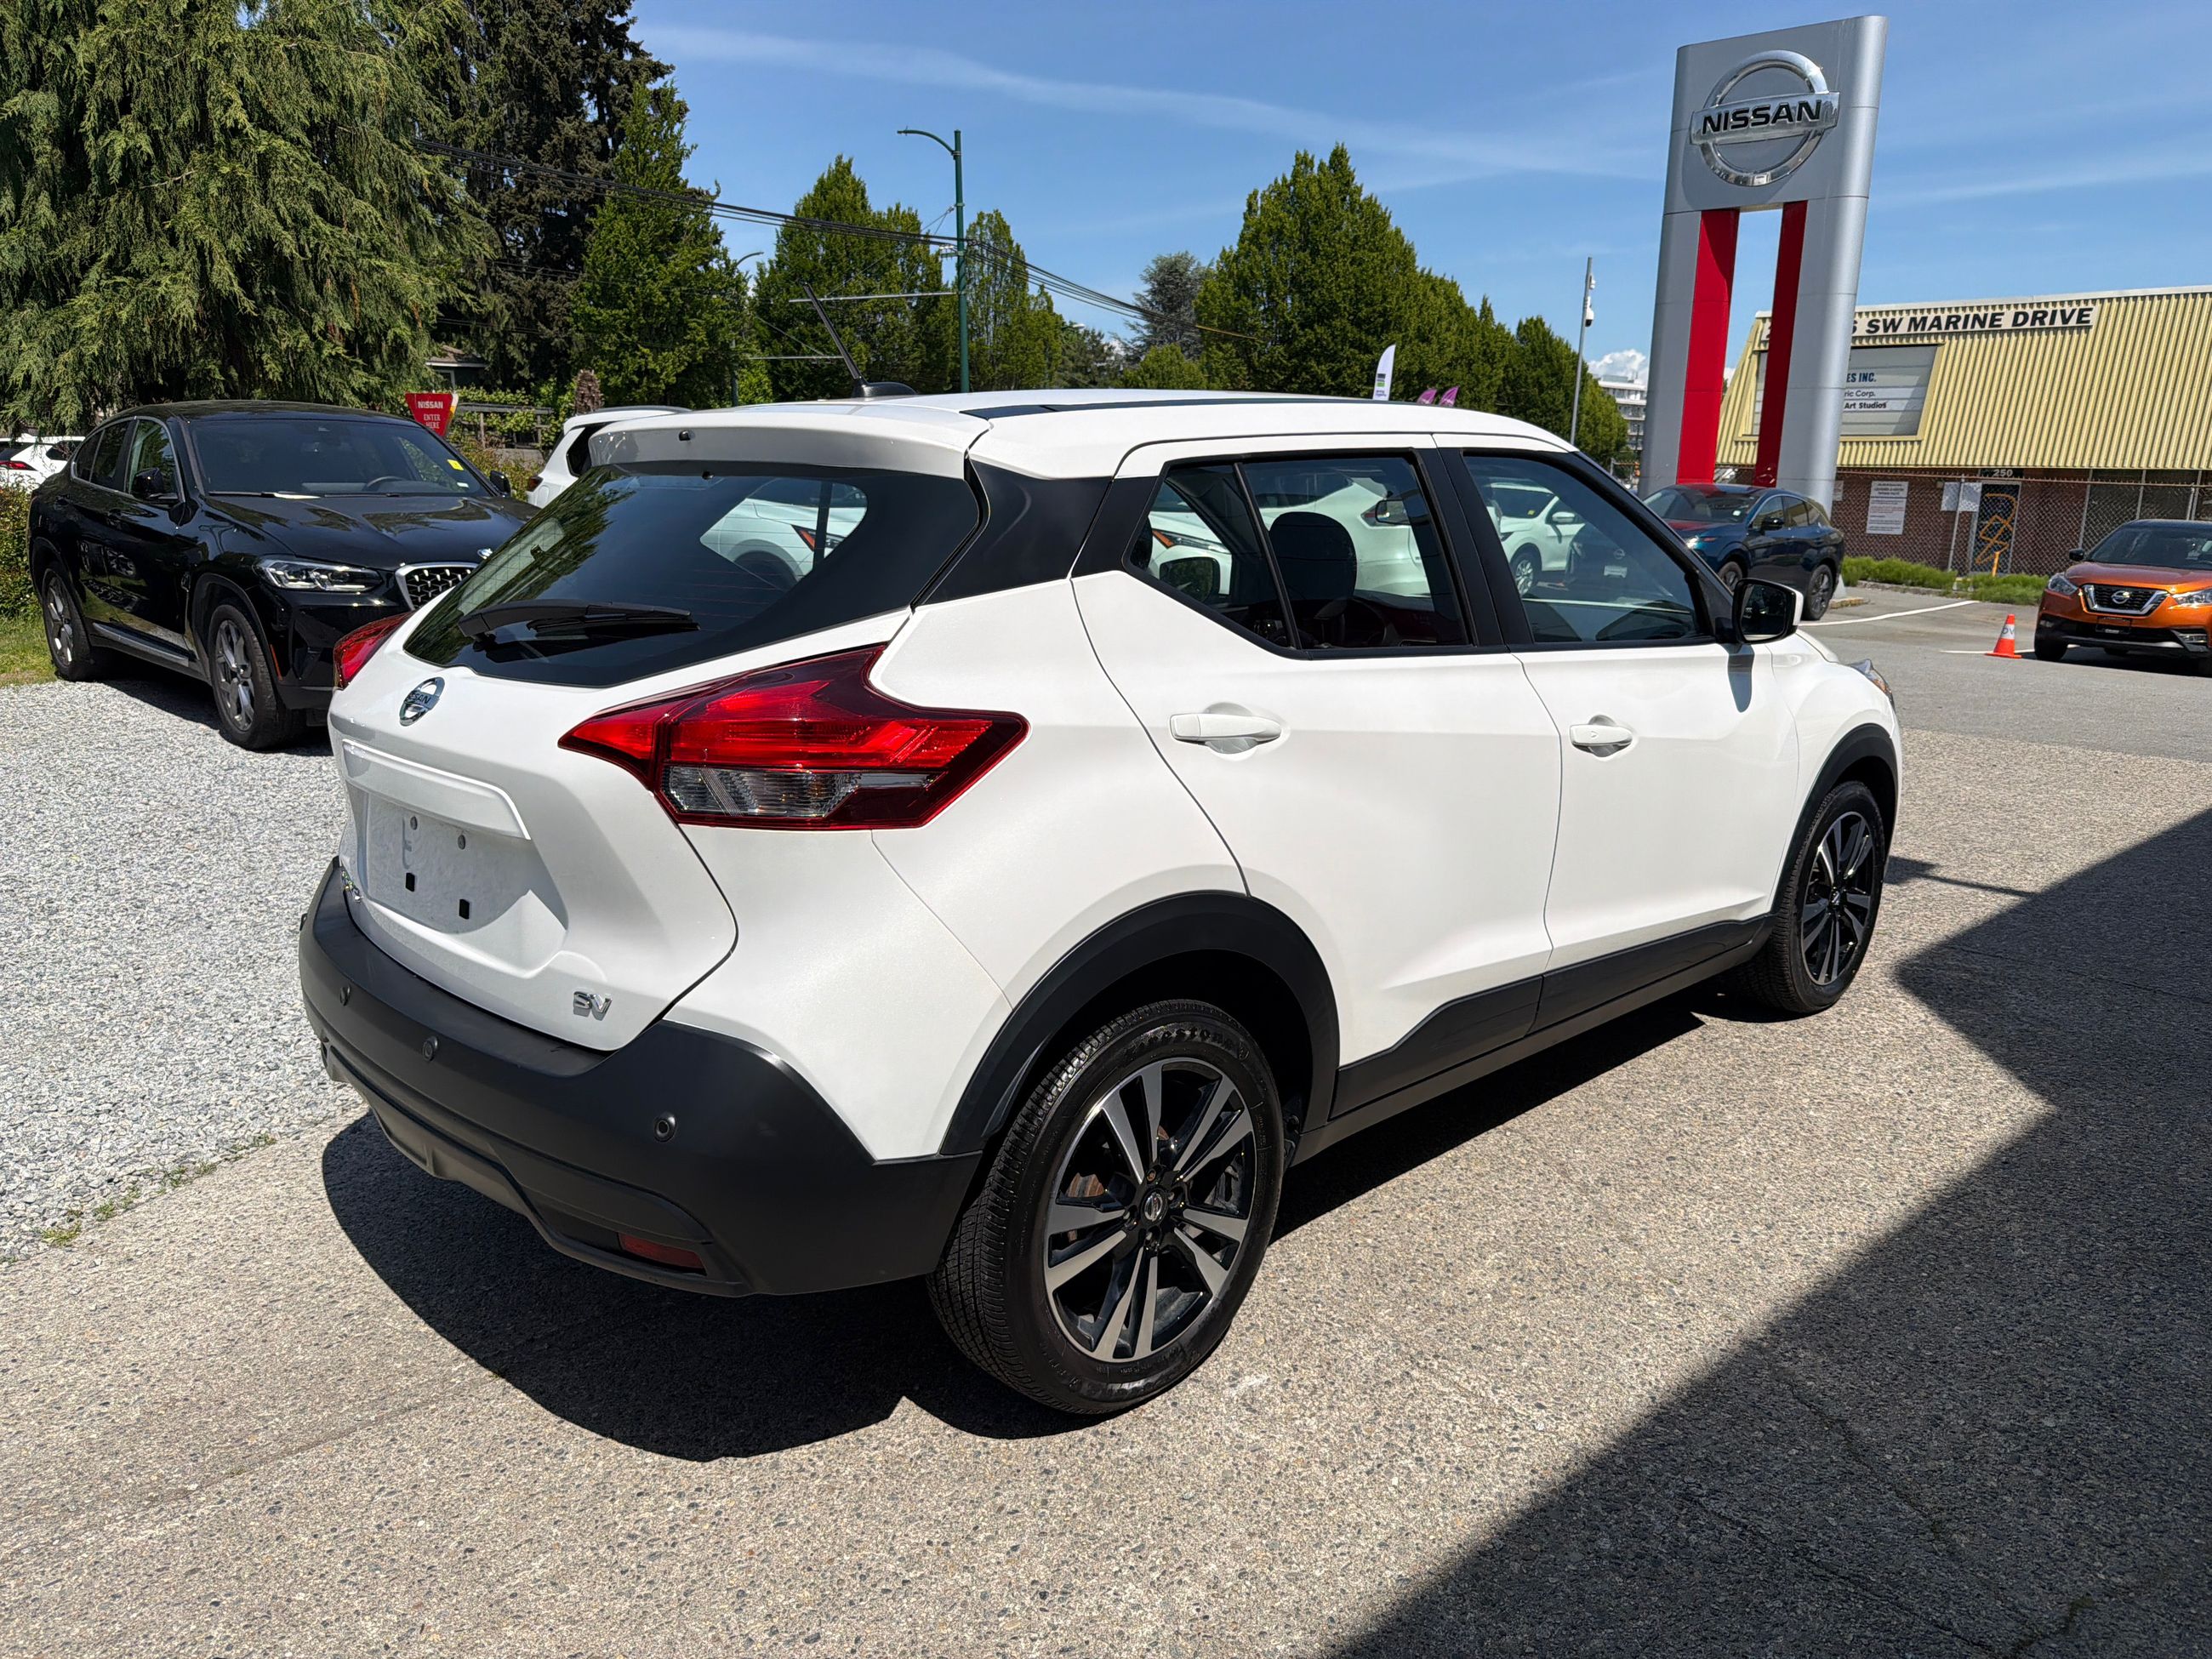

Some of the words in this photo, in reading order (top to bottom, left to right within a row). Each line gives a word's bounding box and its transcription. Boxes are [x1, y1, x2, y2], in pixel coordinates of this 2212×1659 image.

[1702, 100, 1821, 134] NISSAN
[1865, 317, 1904, 334] SW
[1907, 312, 2005, 333] MARINE
[2011, 307, 2094, 328] DRIVE
[1858, 373, 1877, 383] INC.
[1993, 469, 2014, 477] 250
[573, 990, 613, 1017] SV
